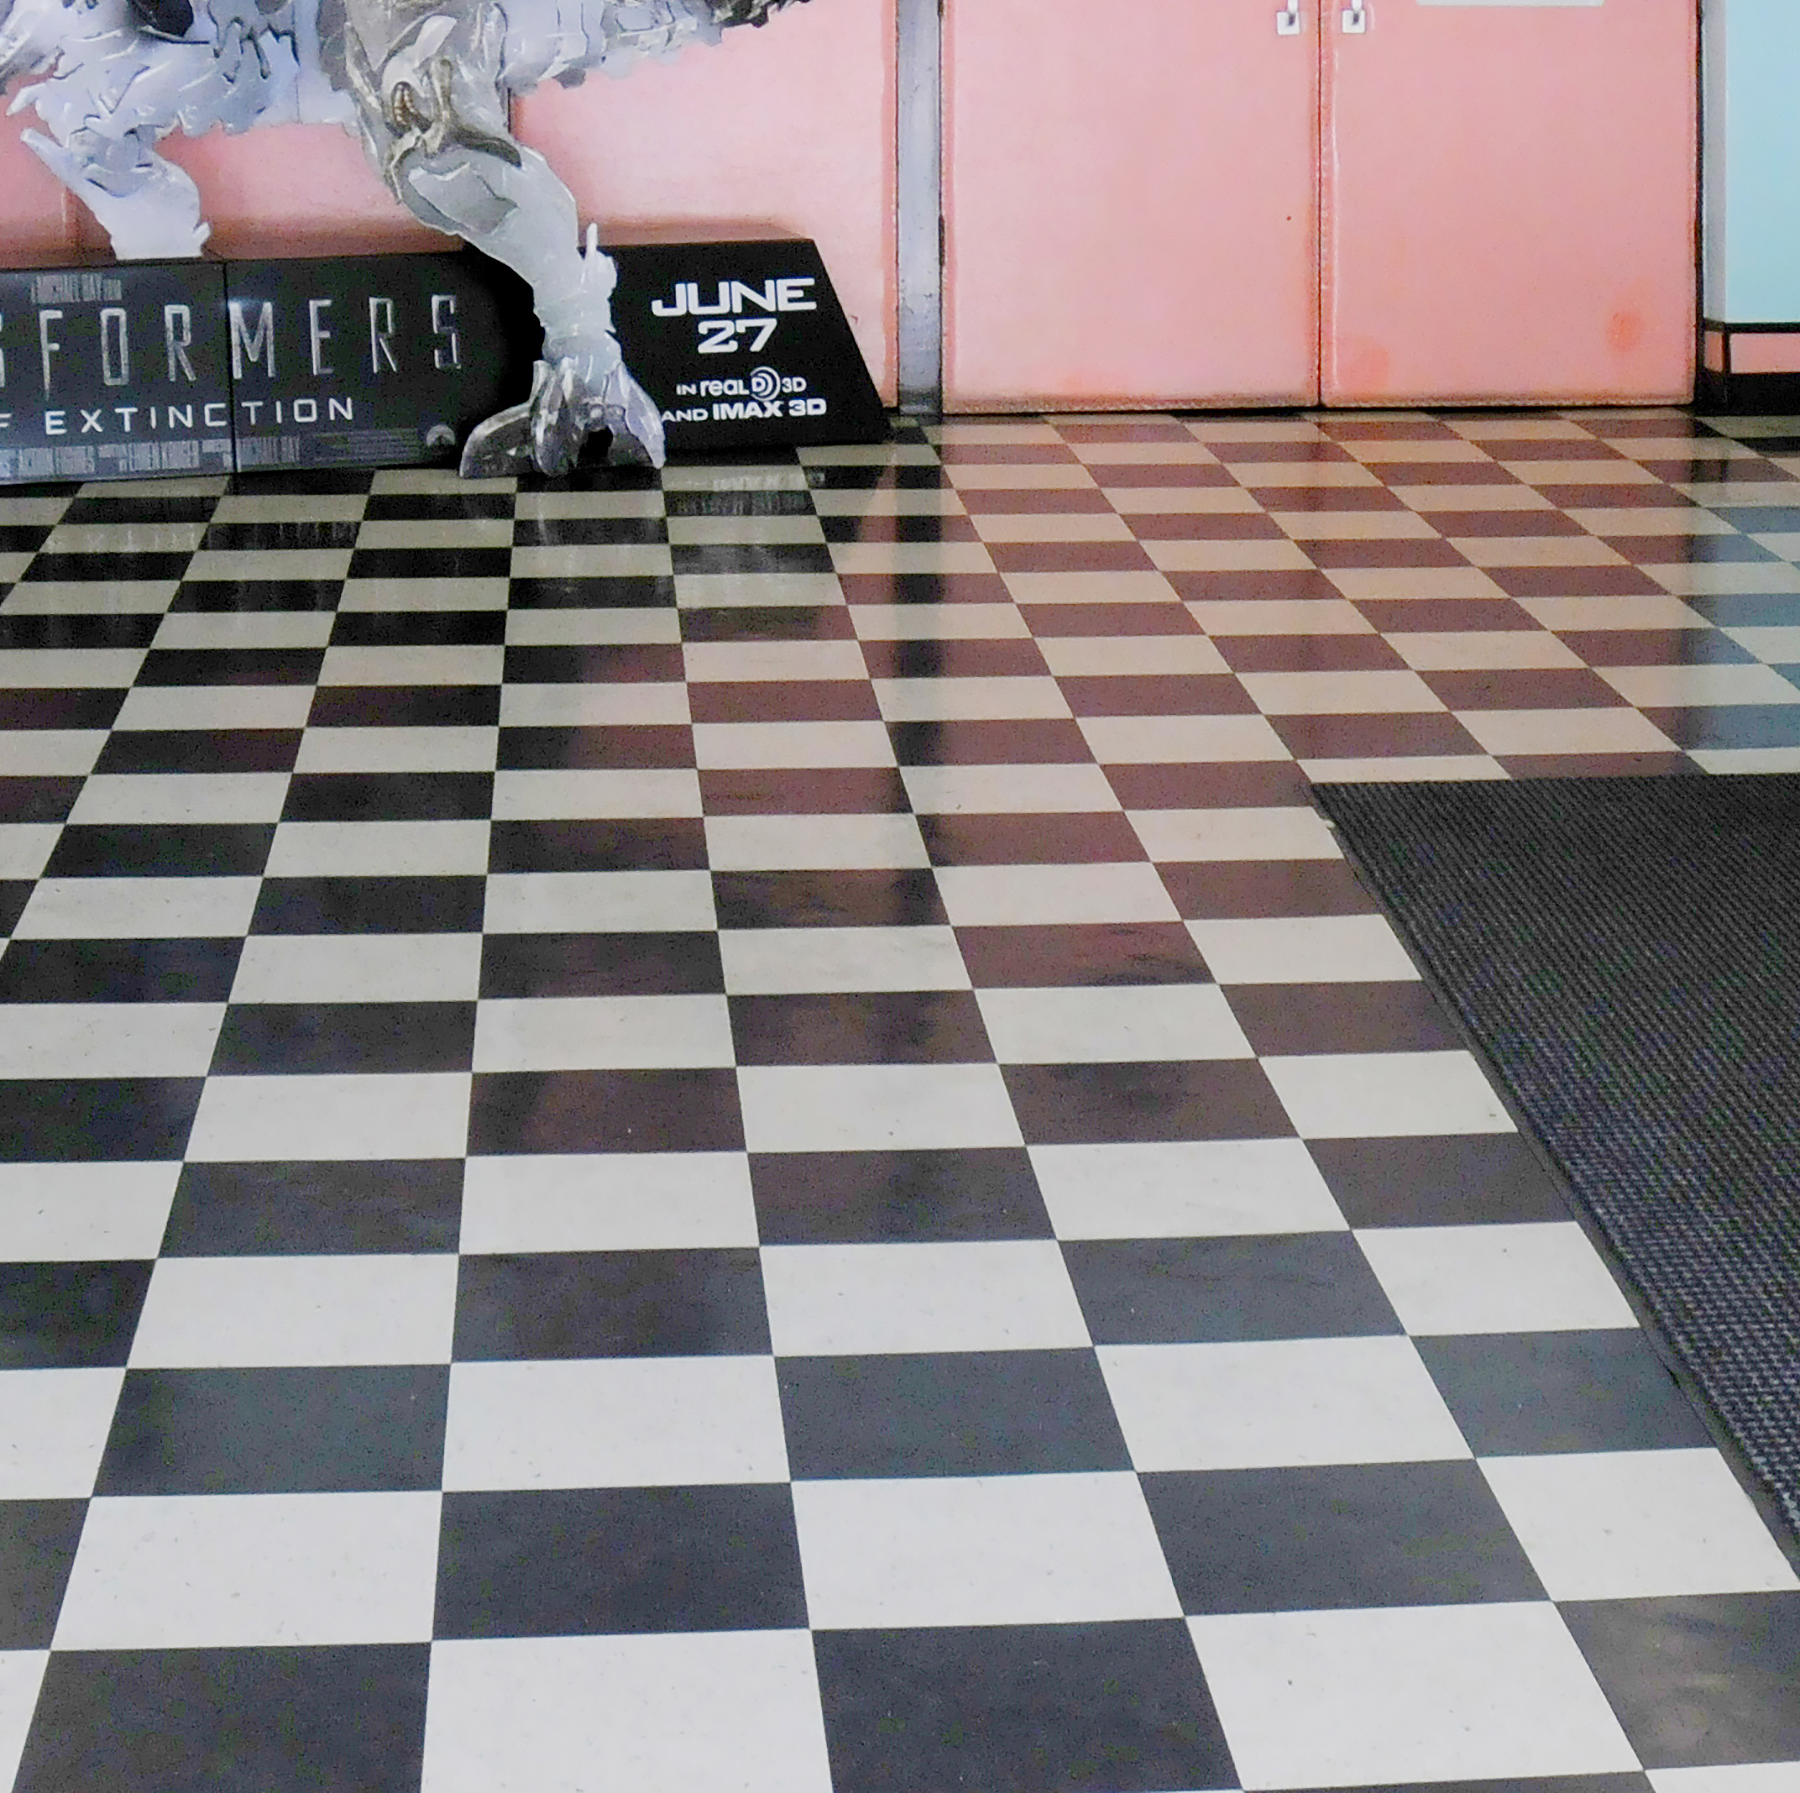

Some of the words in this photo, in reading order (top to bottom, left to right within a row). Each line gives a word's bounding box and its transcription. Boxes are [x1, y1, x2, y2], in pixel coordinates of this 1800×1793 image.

[651, 277, 817, 318] JUNE
[697, 317, 778, 355] 27
[676, 383, 697, 396] IN
[781, 377, 808, 393] 3D
[44, 397, 355, 436] EXTINCTION
[660, 407, 709, 422] AND
[713, 400, 783, 421] IMAX
[789, 398, 828, 417] 3D
